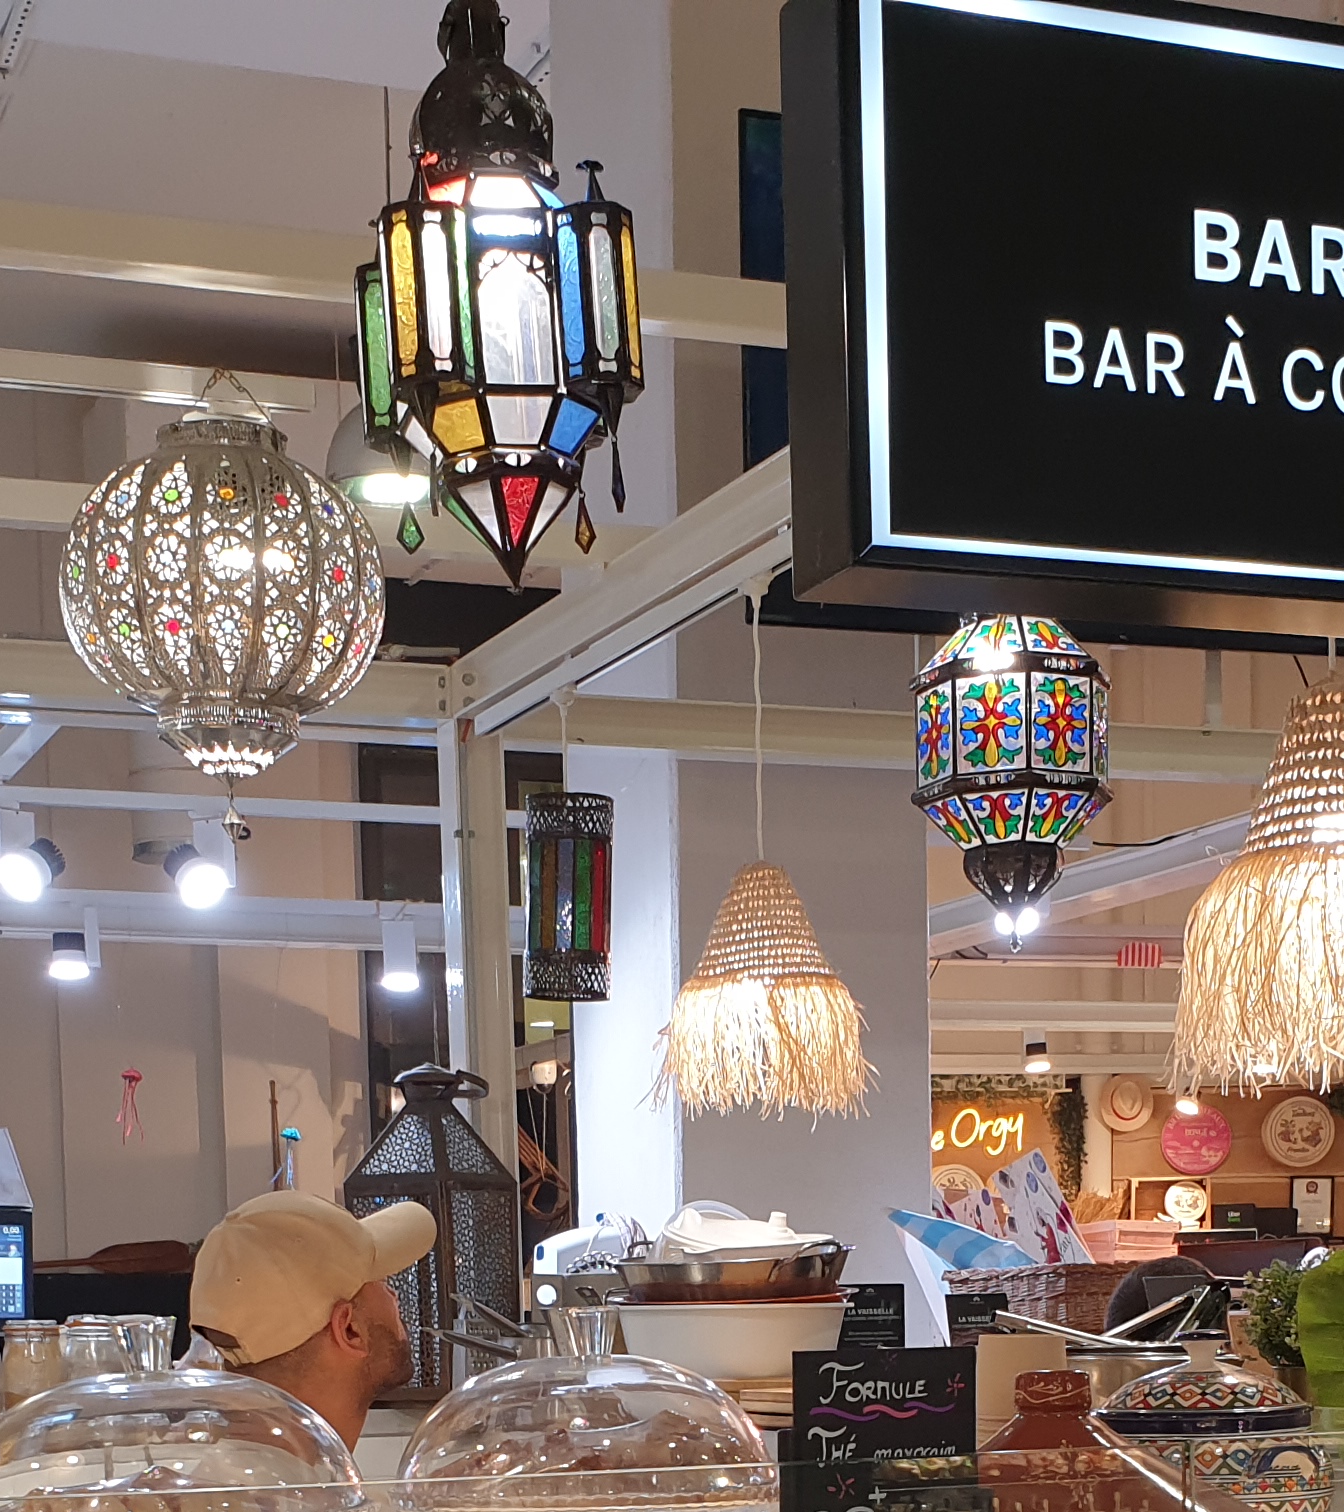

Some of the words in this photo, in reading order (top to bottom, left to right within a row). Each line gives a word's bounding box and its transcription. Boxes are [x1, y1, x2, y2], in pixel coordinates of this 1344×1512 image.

[1043, 319, 1186, 398] BAR
[1213, 315, 1256, 405] À
[950, 1108, 1024, 1156] Orgy
[868, 1486, 887, 1505] +
